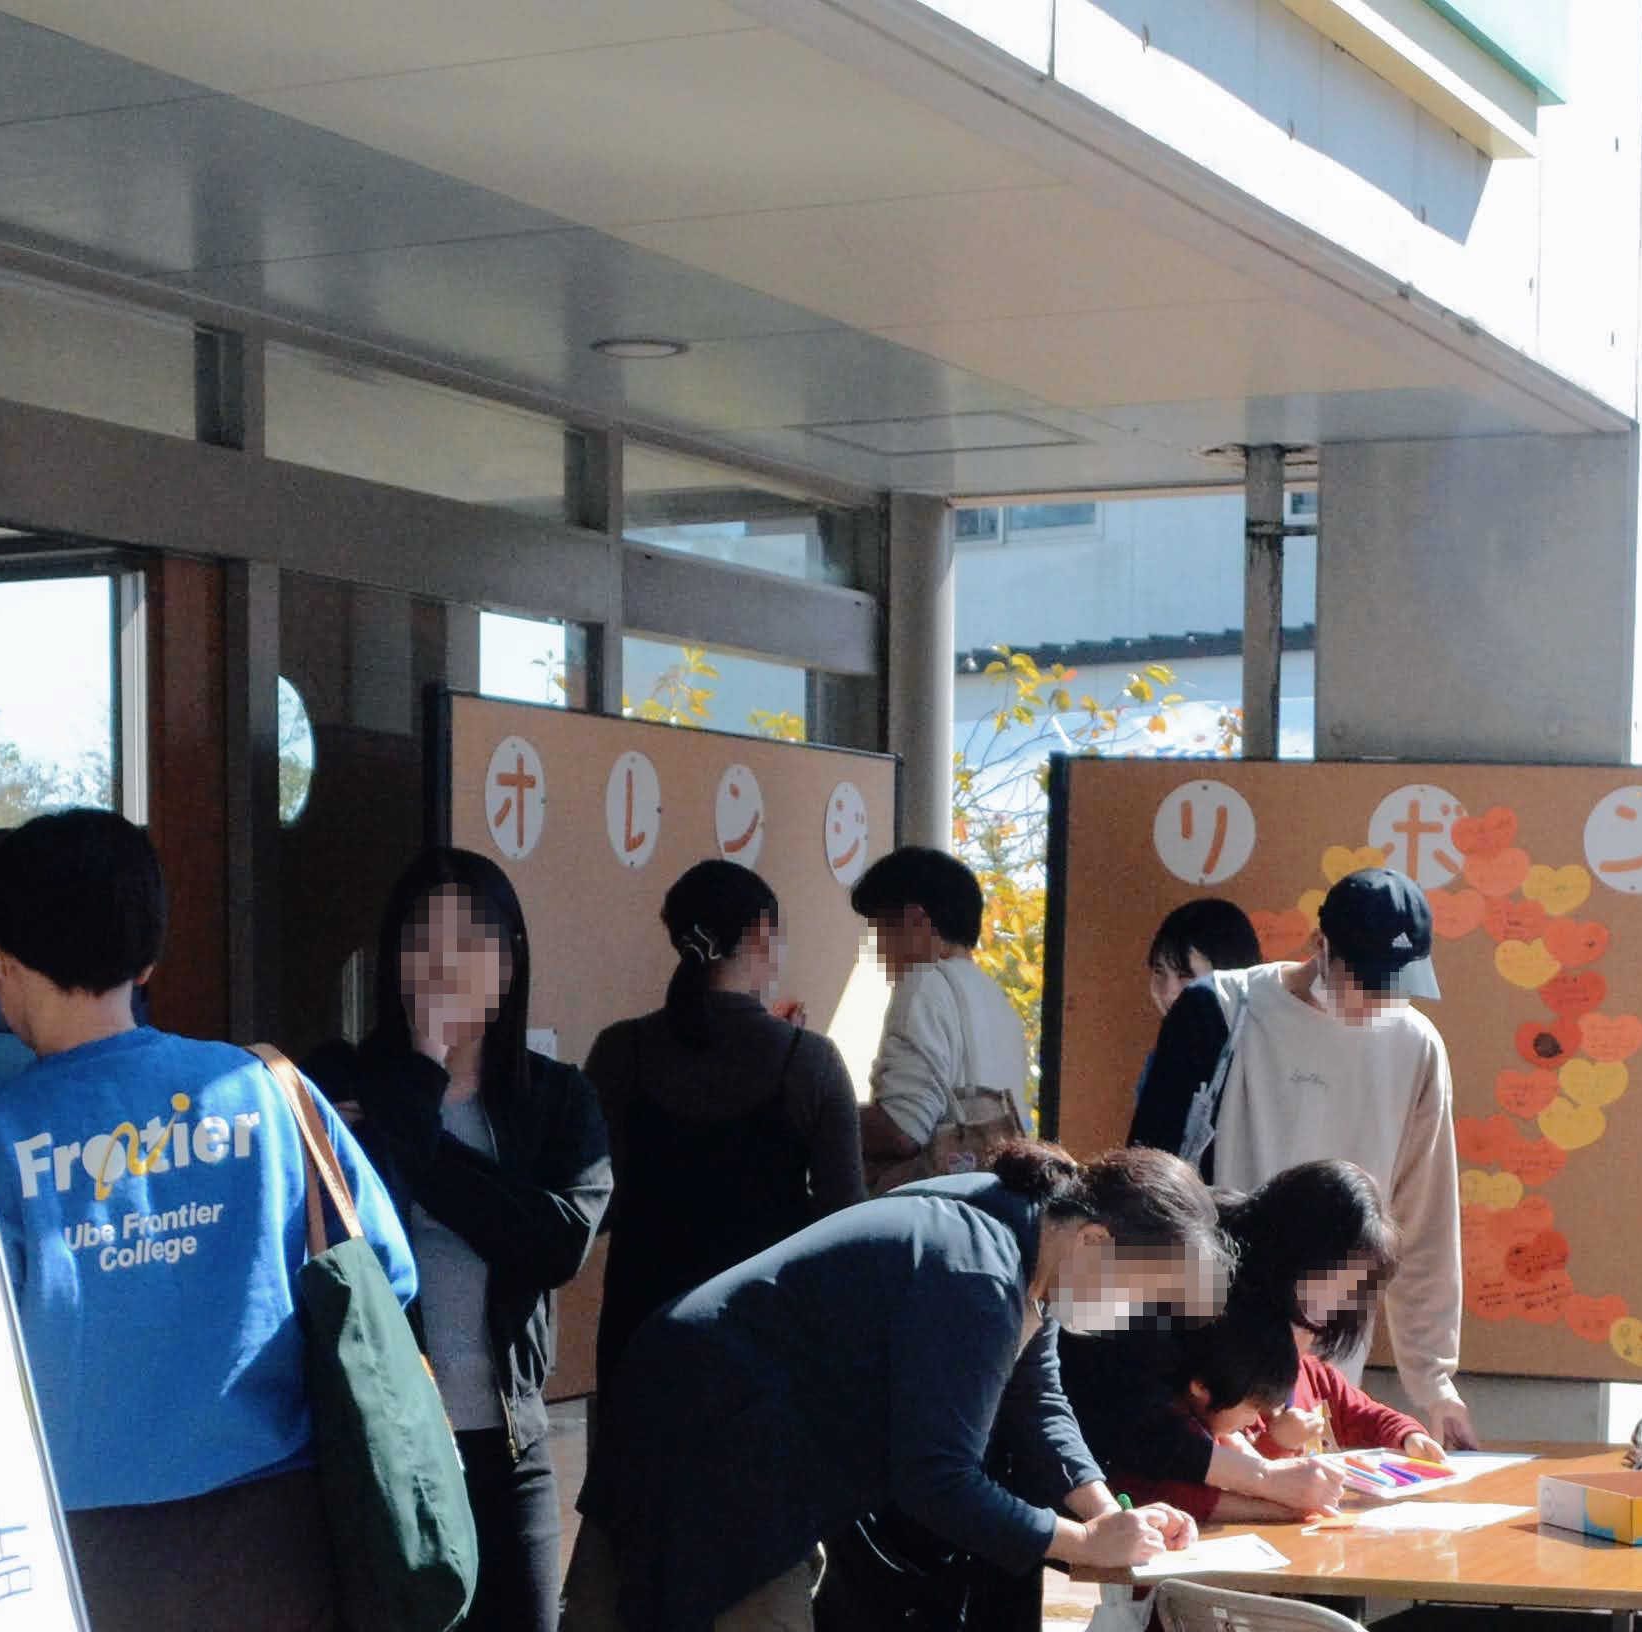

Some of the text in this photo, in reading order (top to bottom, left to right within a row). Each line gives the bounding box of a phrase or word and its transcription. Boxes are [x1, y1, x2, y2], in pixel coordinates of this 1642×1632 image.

[14, 1092, 260, 1200] Frontier
[63, 1201, 225, 1251] Ube Frontier
[99, 1234, 198, 1271] College
